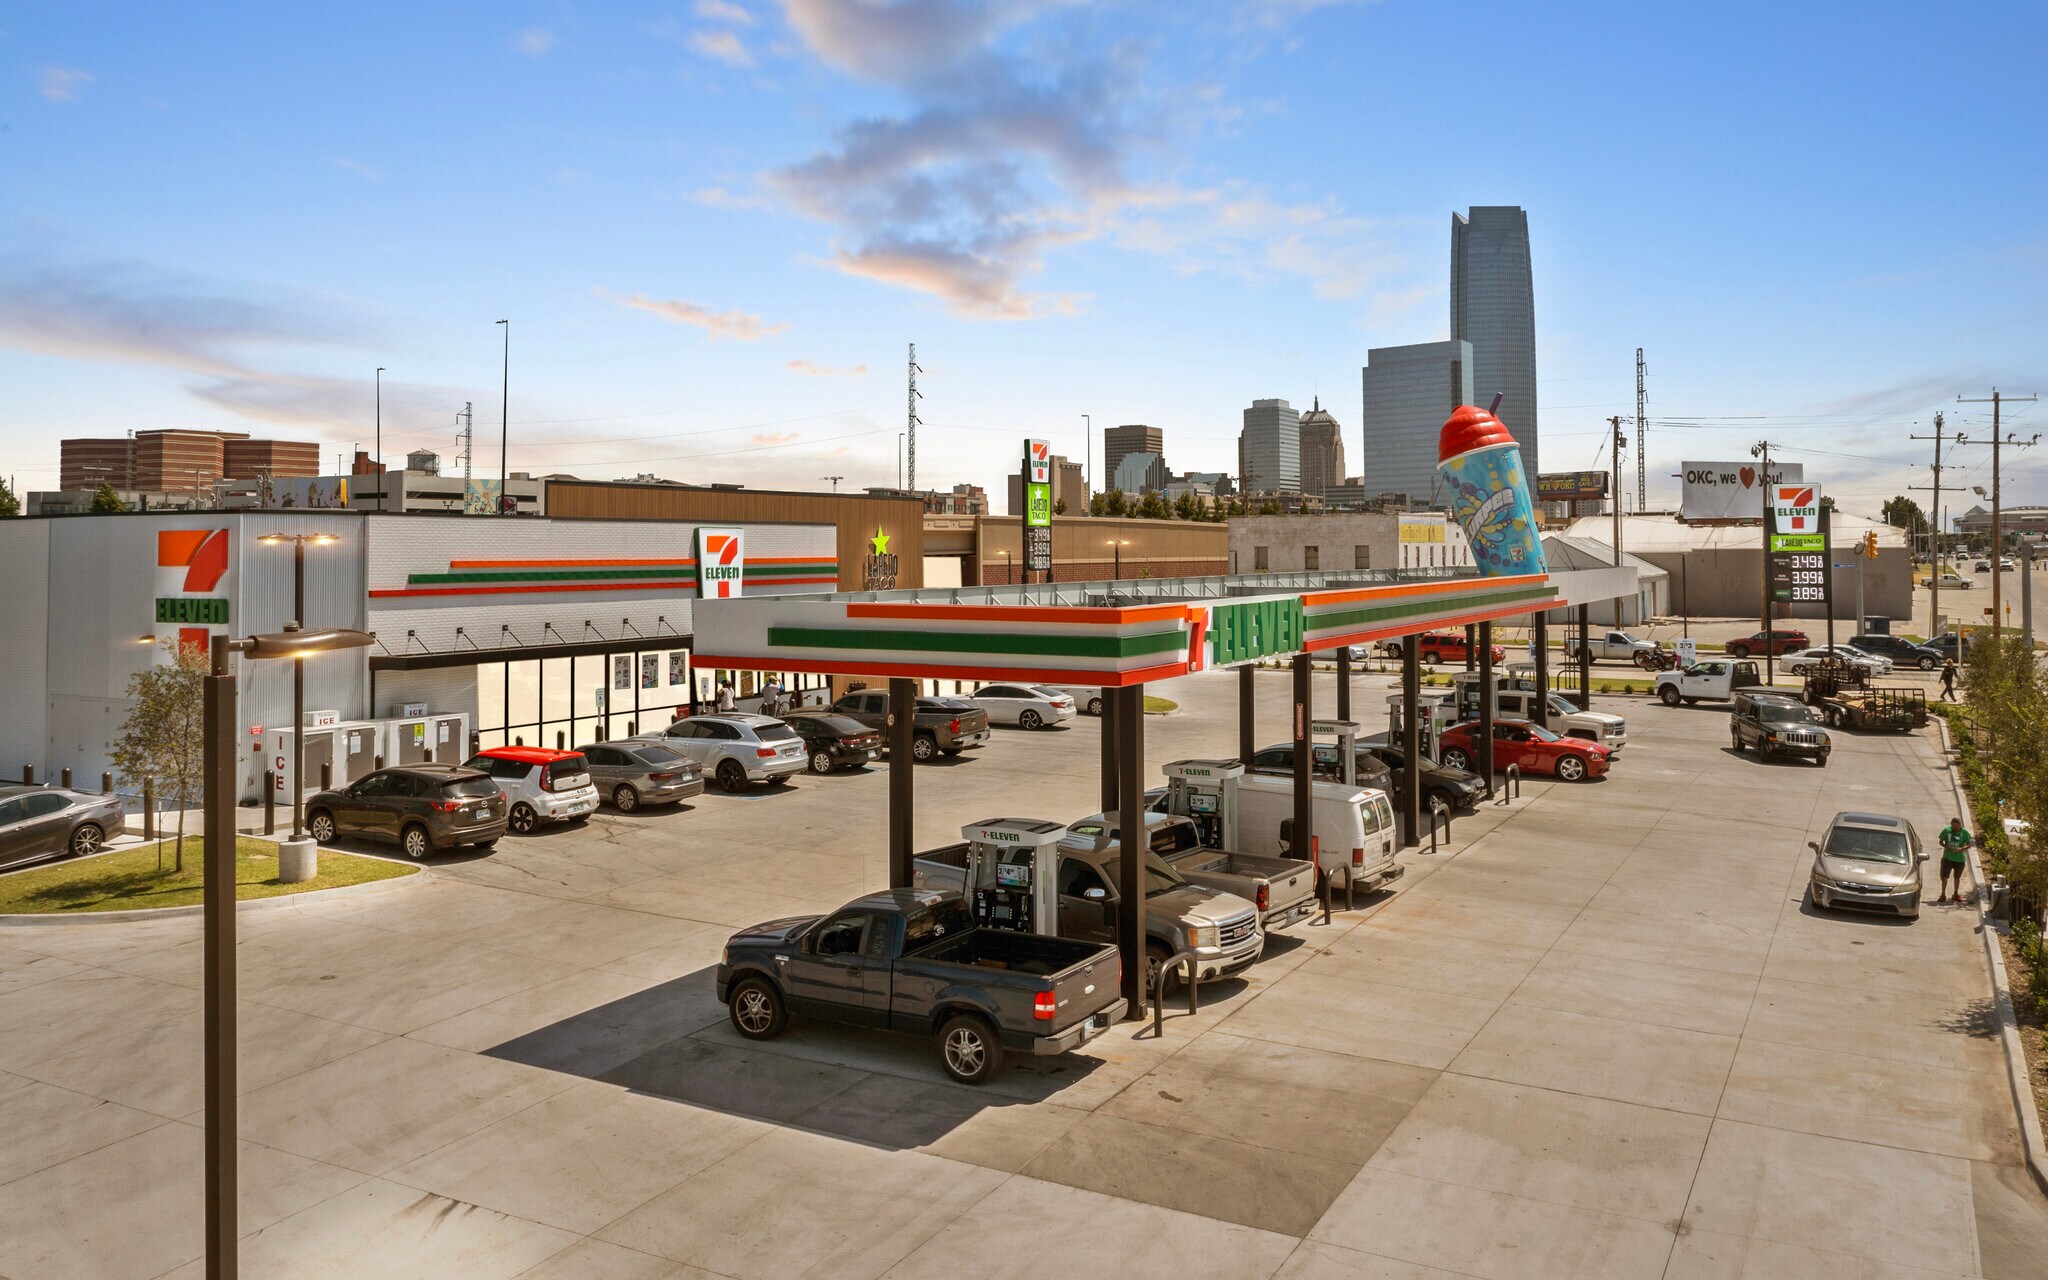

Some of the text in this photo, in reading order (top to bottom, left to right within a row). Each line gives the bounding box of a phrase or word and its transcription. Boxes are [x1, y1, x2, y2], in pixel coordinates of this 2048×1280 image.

[1687, 470, 1717, 486] OKC,
[1720, 473, 1737, 484] we
[1032, 512, 1046, 520] TACO
[1791, 555, 1817, 568] 3.49
[1792, 571, 1817, 584] 3.99
[1792, 587, 1818, 600] 3.89
[320, 717, 334, 725] ICE
[275, 735, 285, 790] ICE
